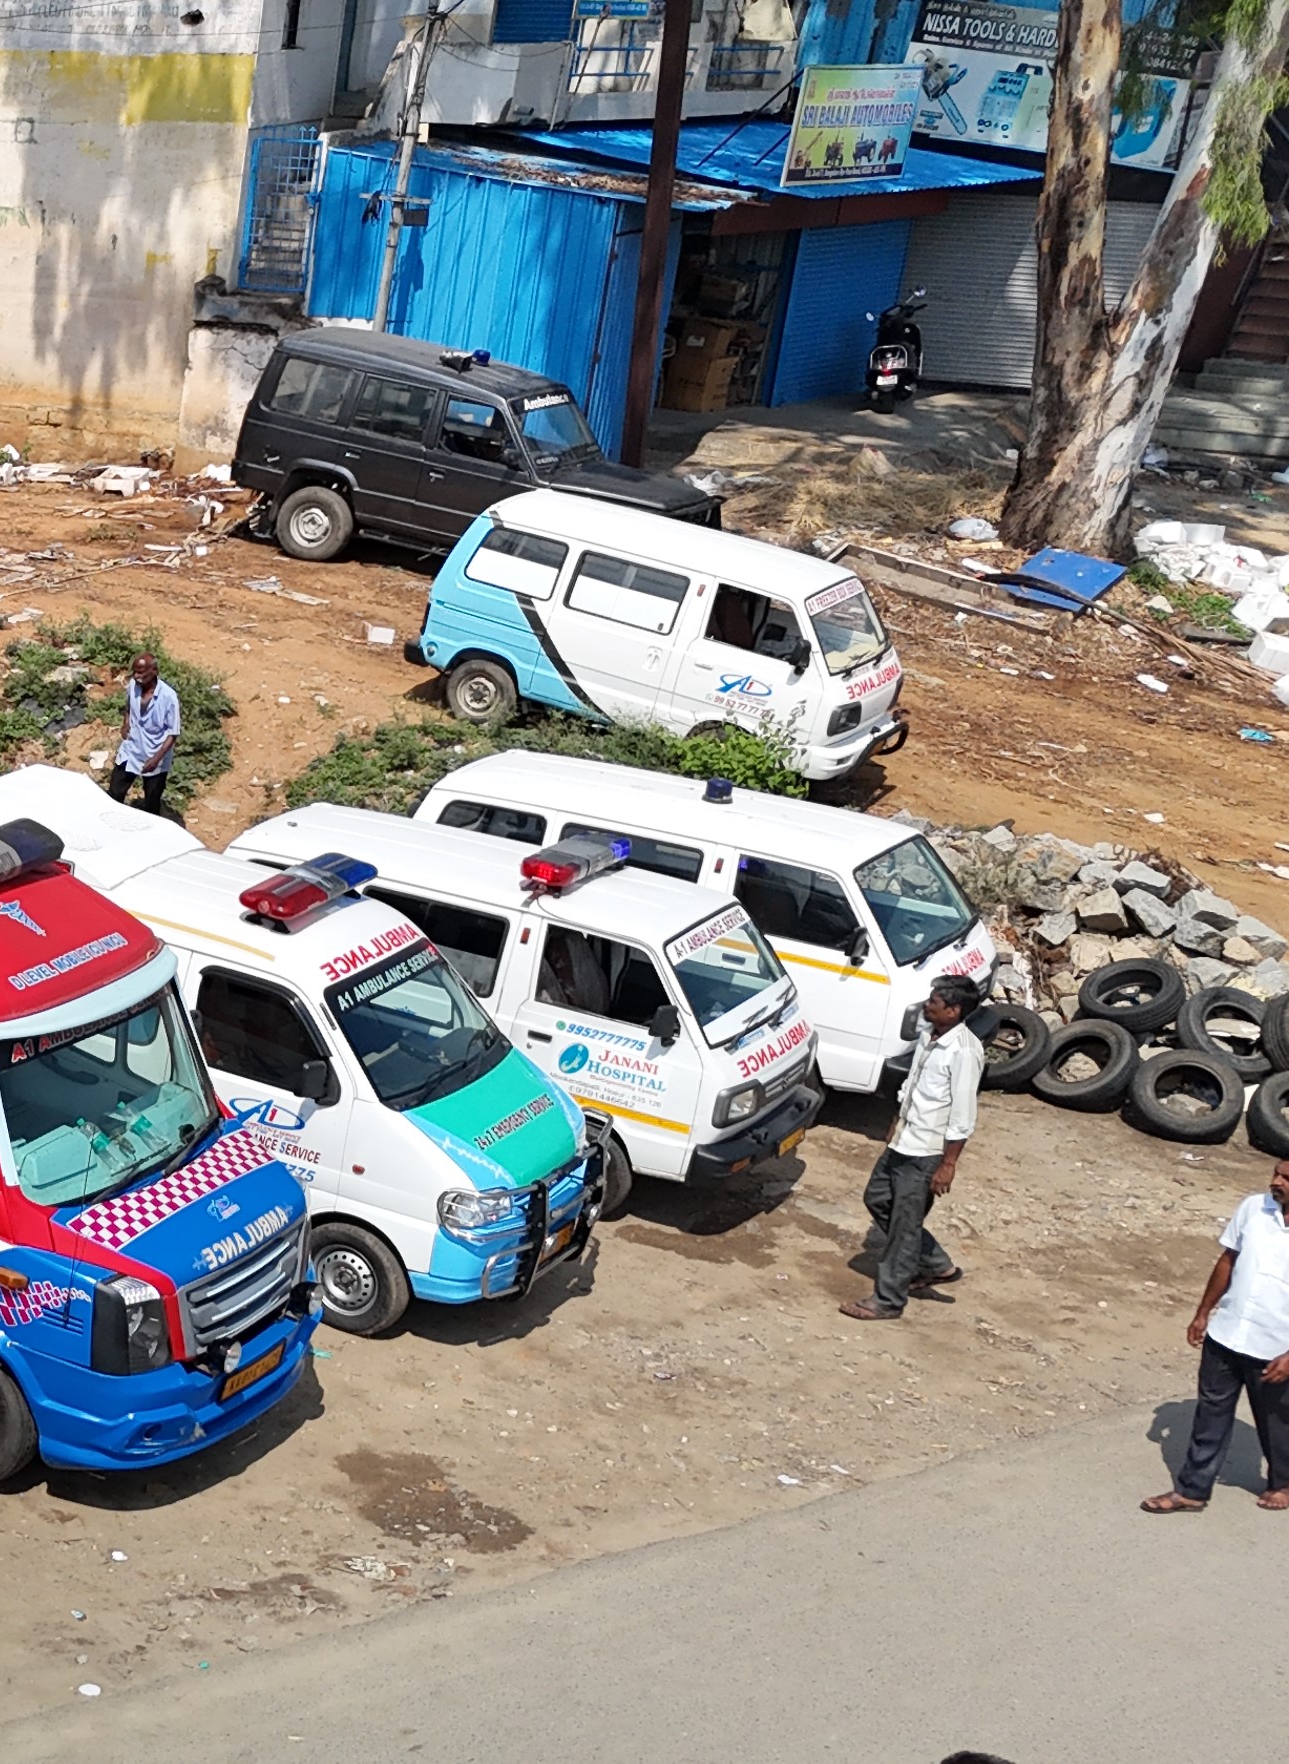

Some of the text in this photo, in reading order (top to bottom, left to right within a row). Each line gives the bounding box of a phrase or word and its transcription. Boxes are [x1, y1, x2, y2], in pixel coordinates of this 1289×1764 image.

[923, 12, 959, 34] NISSA
[962, 17, 1004, 41] TOOLS
[1019, 25, 1059, 49] HARD
[817, 104, 850, 127] BALAJI
[849, 103, 915, 126] AUTOMOBILES
[24, 947, 90, 985] LEVEL MOBILE
[337, 964, 409, 1012] A1 AMBULANCE
[11, 1039, 34, 1063] A1
[566, 1023, 647, 1052] 9952777775
[586, 1059, 667, 1092] HOSPITAL
[598, 1049, 659, 1075] JANANI
[280, 1142, 321, 1163] SERVICE
